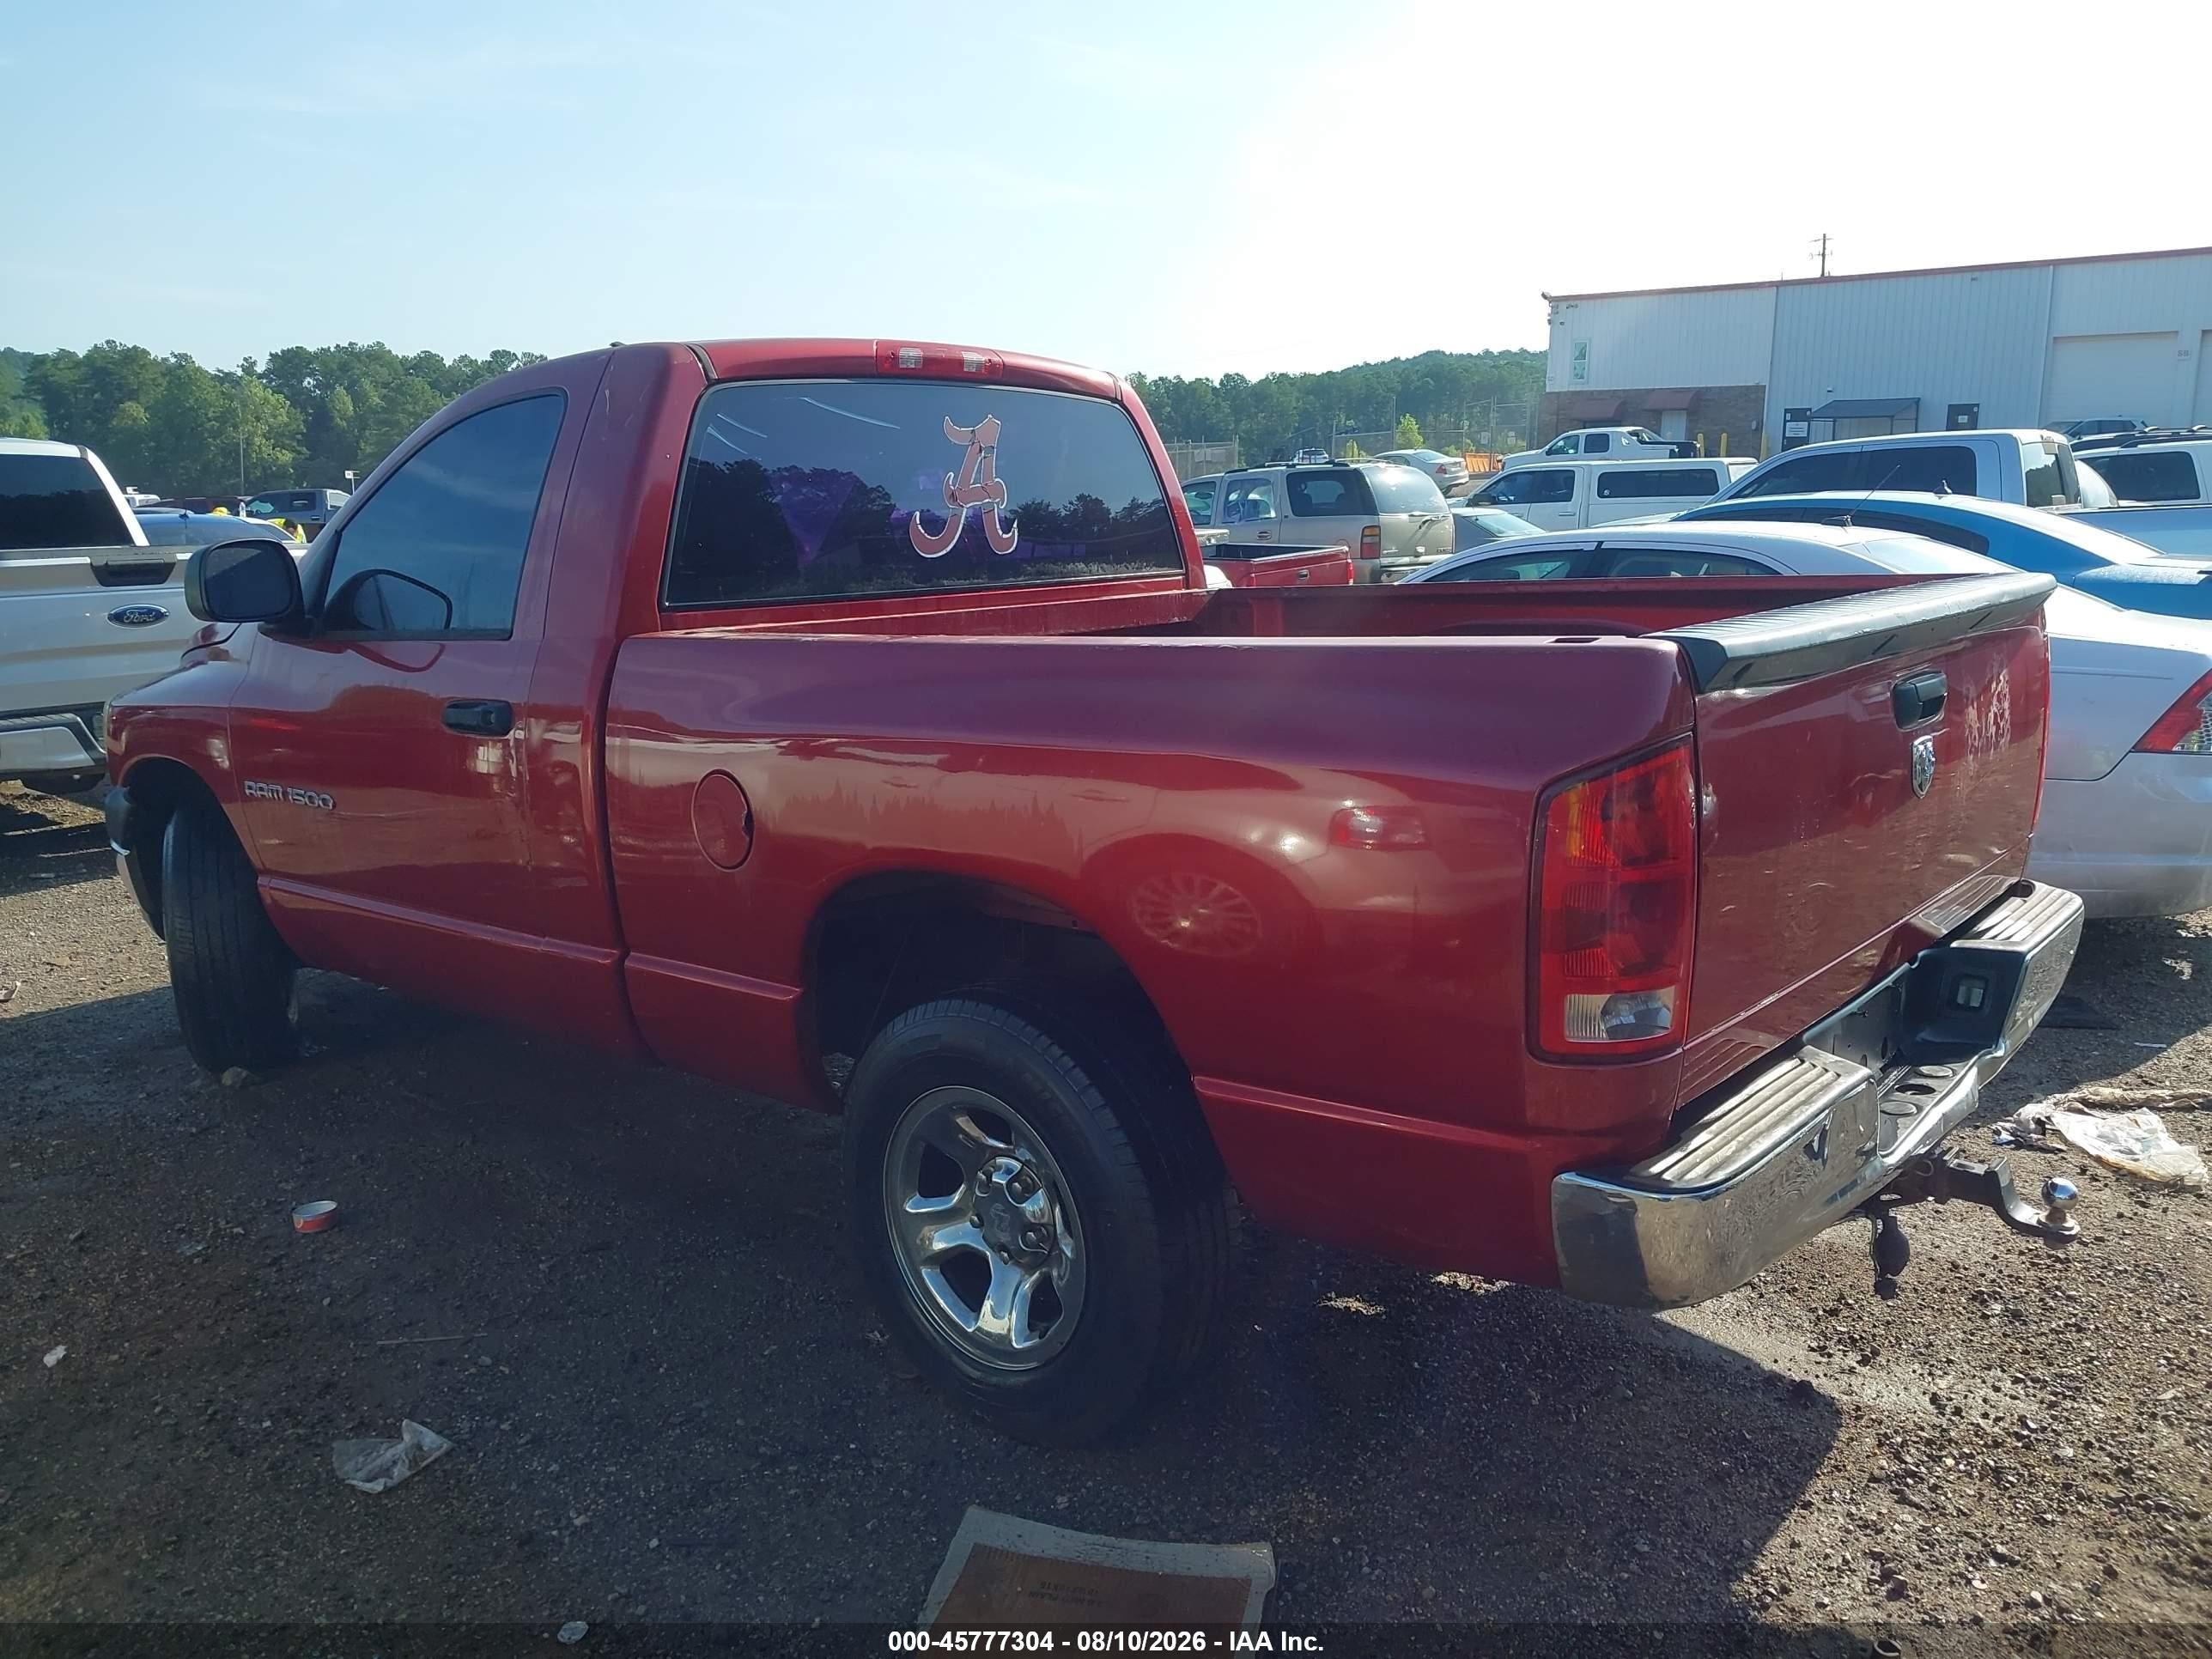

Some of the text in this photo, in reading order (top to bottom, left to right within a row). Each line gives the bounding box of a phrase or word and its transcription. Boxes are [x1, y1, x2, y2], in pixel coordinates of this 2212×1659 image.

[909, 414, 1018, 558] A
[124, 609, 155, 623] Ford
[244, 781, 335, 810] RAM 1500
